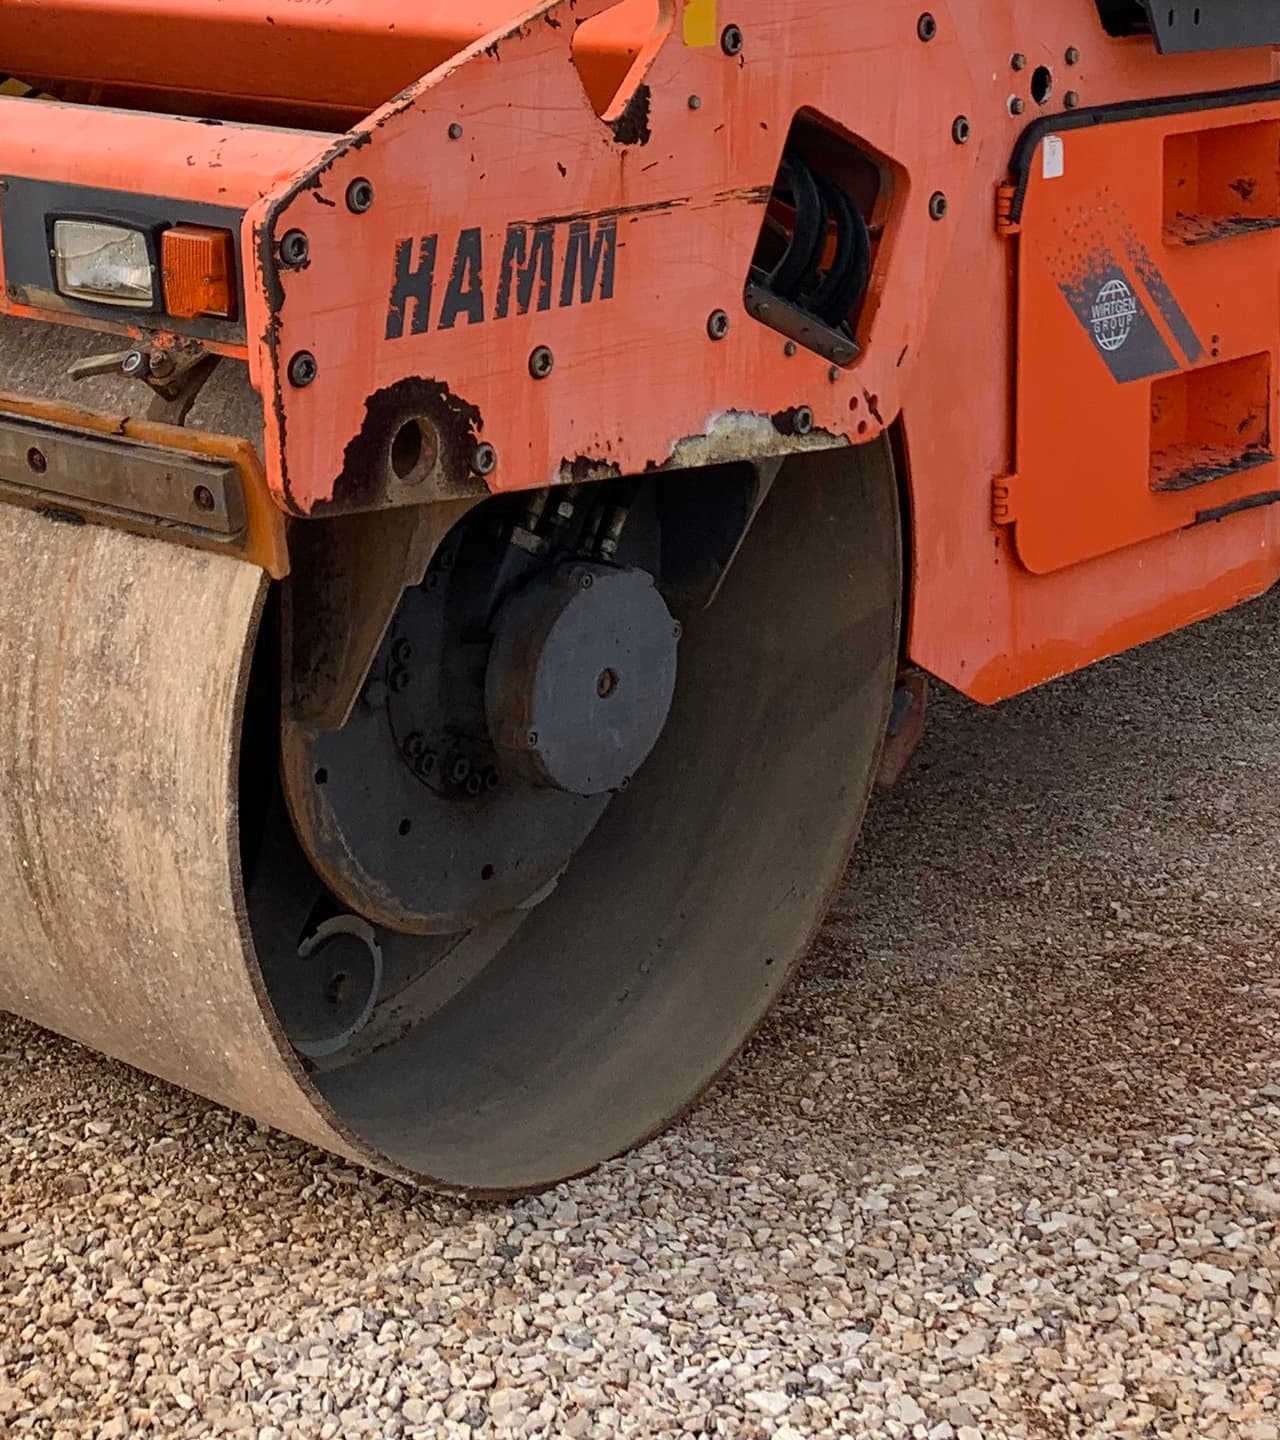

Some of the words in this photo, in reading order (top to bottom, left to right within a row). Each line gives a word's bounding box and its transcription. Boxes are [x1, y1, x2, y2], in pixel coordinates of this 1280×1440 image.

[384, 216, 618, 340] HAMM
[1091, 296, 1136, 319] WIRTGEN
[1094, 314, 1132, 333] GROUP
